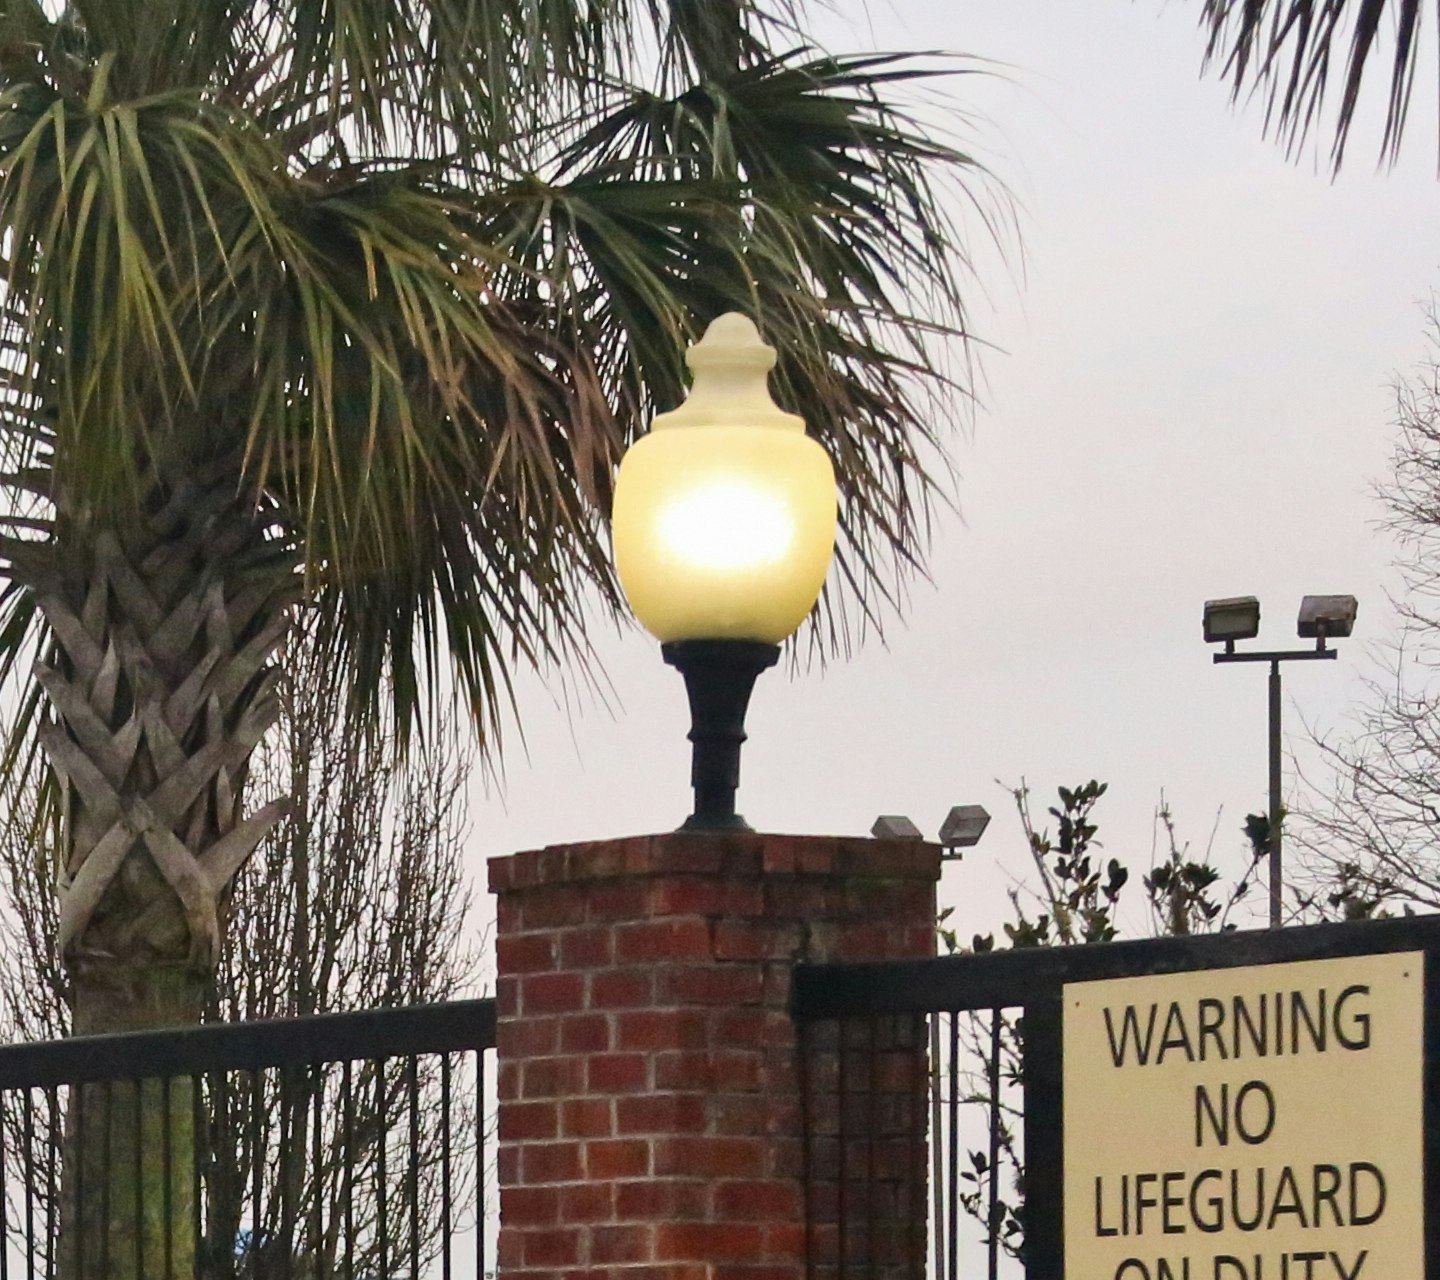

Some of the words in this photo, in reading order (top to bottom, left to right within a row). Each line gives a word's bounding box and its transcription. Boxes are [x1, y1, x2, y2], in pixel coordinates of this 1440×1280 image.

[1103, 984, 1373, 1068] WARNING
[1195, 1080, 1277, 1147] NO
[1094, 1161, 1387, 1237] LIFEGUARD
